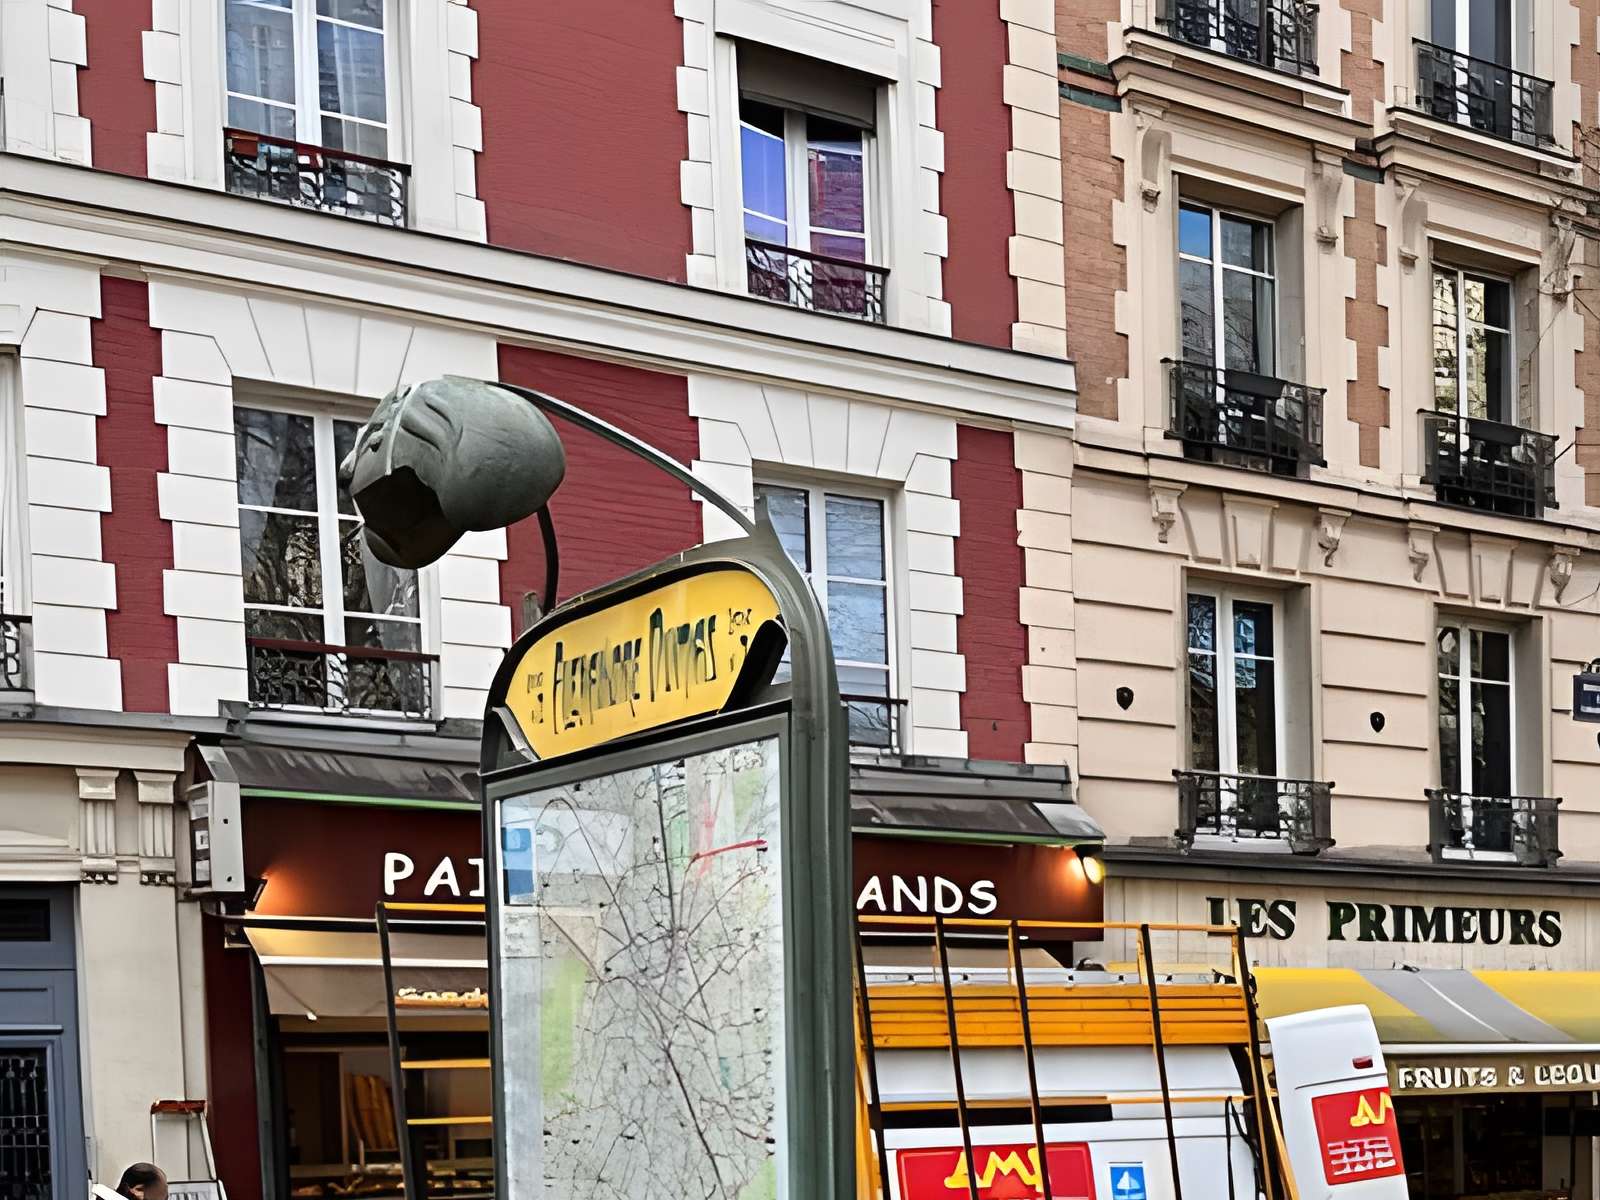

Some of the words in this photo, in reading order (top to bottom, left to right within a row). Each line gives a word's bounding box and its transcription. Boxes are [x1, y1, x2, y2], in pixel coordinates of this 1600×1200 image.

[1206, 896, 1296, 940] LES
[1326, 901, 1562, 947] PRIMEURS
[1398, 1066, 1498, 1089] FRUITS
